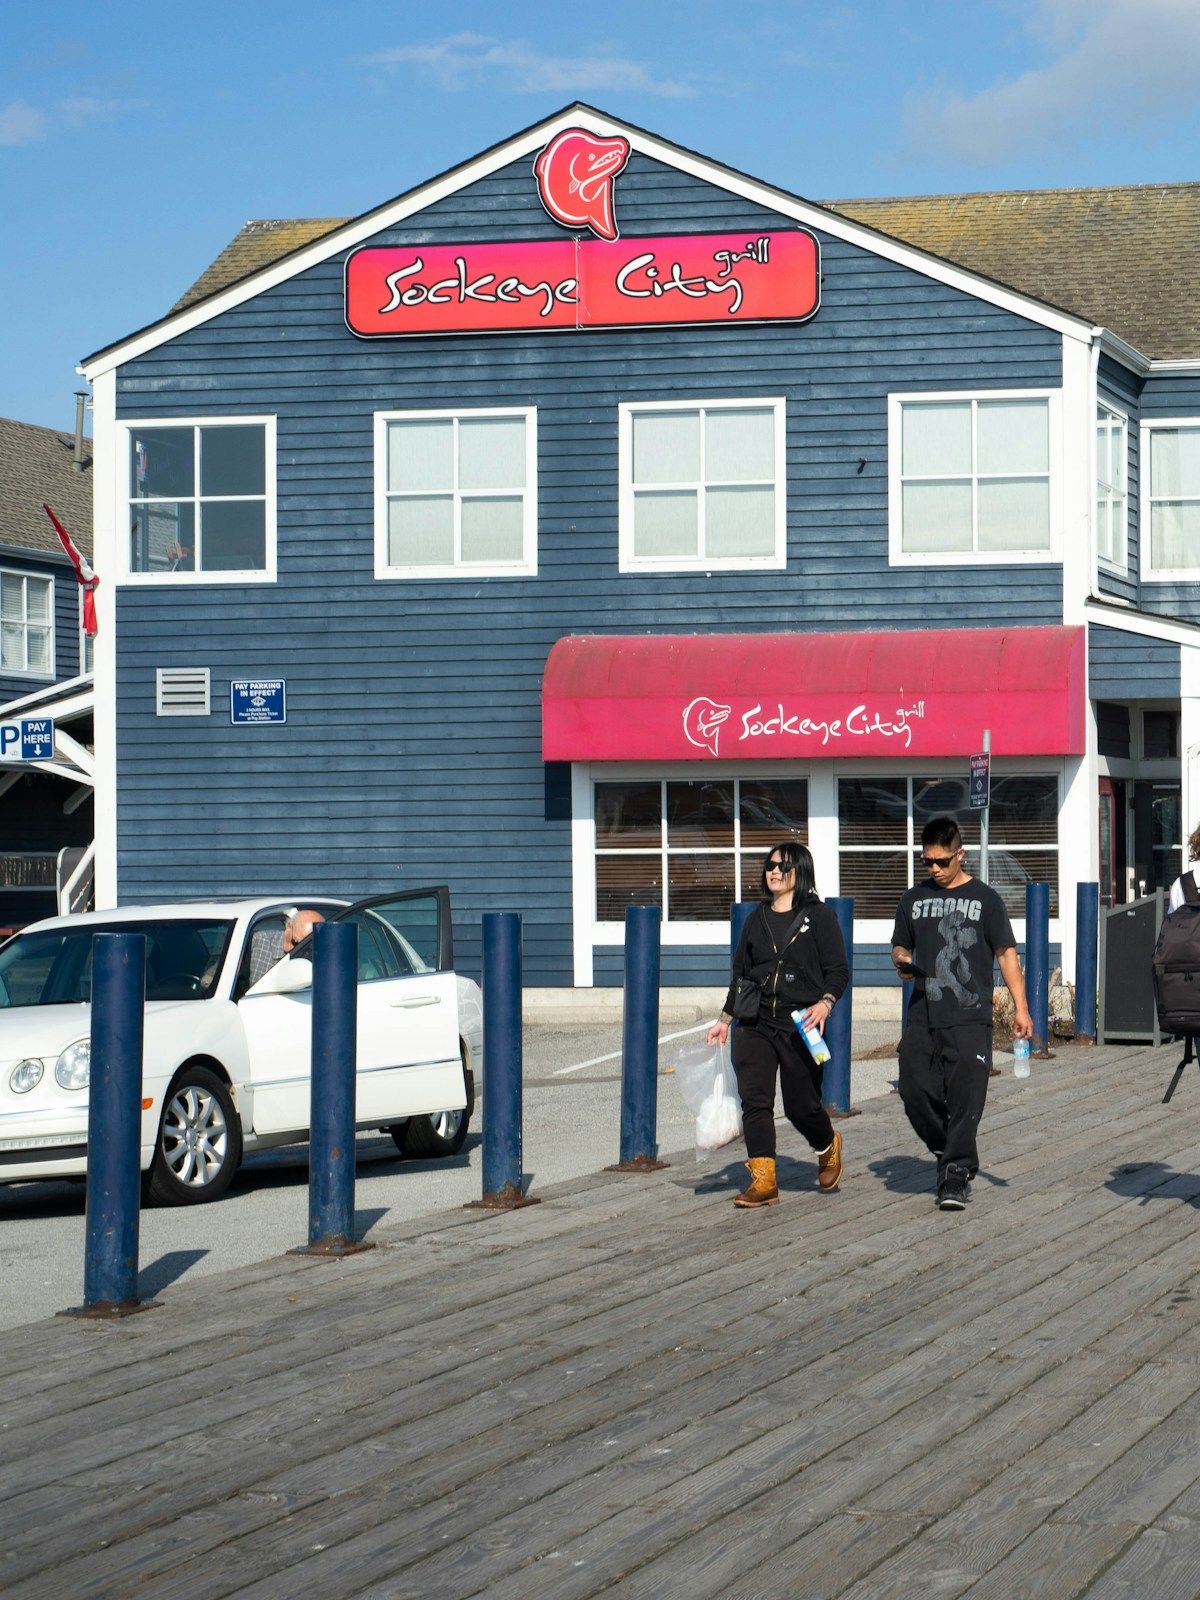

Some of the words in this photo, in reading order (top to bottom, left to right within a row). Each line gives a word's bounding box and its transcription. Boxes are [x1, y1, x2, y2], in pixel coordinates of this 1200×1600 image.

[378, 257, 578, 316] Sockeye
[616, 253, 743, 313] City
[715, 237, 769, 276] grill
[28, 722, 46, 732] PAY
[739, 703, 841, 745] Sockeye
[846, 705, 912, 748] City
[896, 701, 924, 726] grill
[1, 726, 20, 755] P
[24, 734, 50, 744] HERE
[912, 898, 983, 922] STRONG
